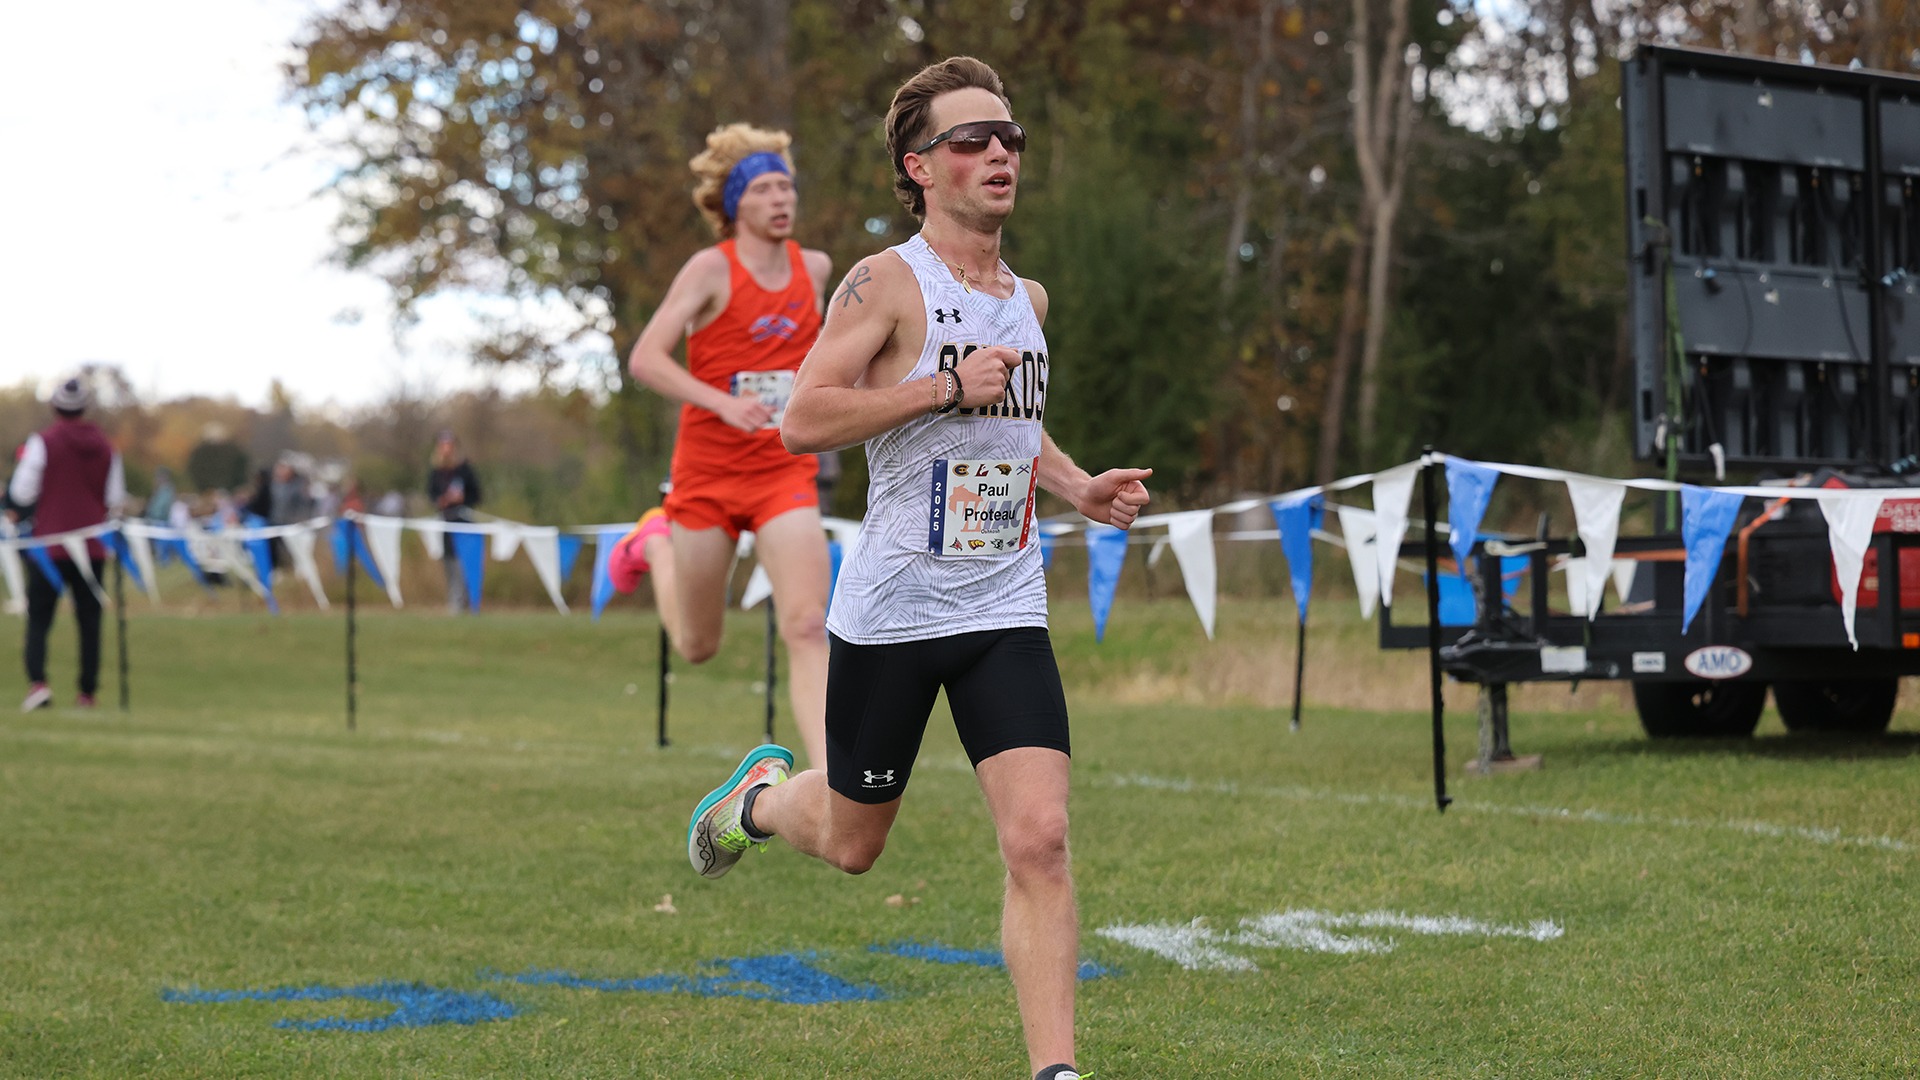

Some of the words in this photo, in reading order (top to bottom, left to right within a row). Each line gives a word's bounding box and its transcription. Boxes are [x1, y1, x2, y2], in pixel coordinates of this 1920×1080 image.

[977, 483, 1009, 496] Paul
[933, 482, 942, 531] 2025
[964, 508, 1016, 521] Proteau
[1696, 651, 1742, 673] AMO
